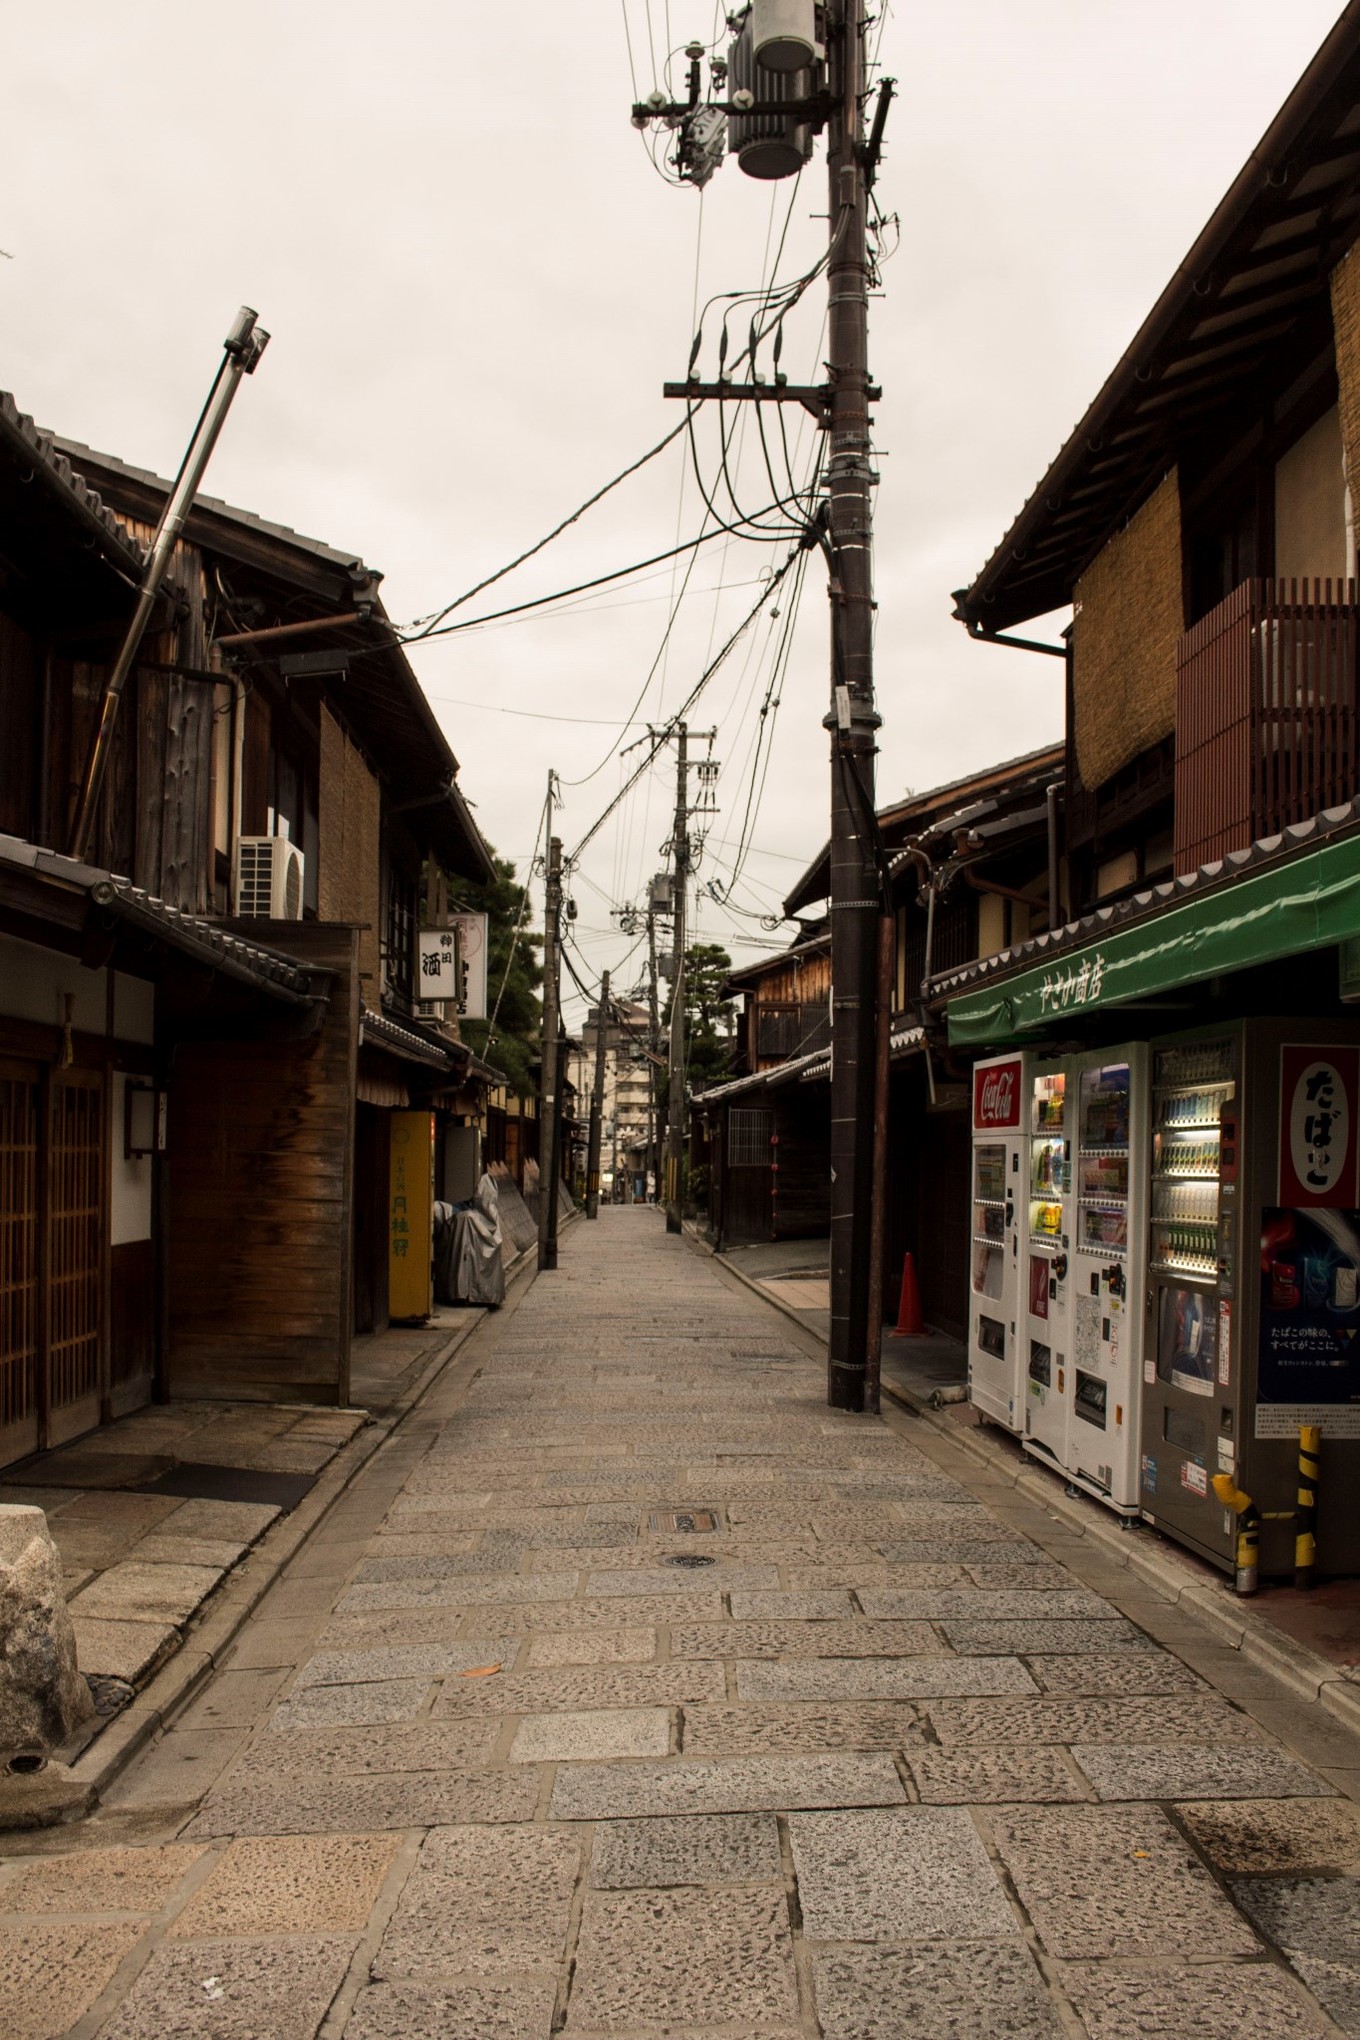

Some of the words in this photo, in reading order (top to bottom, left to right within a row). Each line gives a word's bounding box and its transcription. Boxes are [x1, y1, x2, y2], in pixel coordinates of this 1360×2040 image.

[981, 1072, 1014, 1120] Coca-Cola
[1304, 1071, 1341, 1185] たばこ
[1270, 1340, 1340, 1352] すべてがここに。
[1271, 1326, 1331, 1339] たばこの味の、
